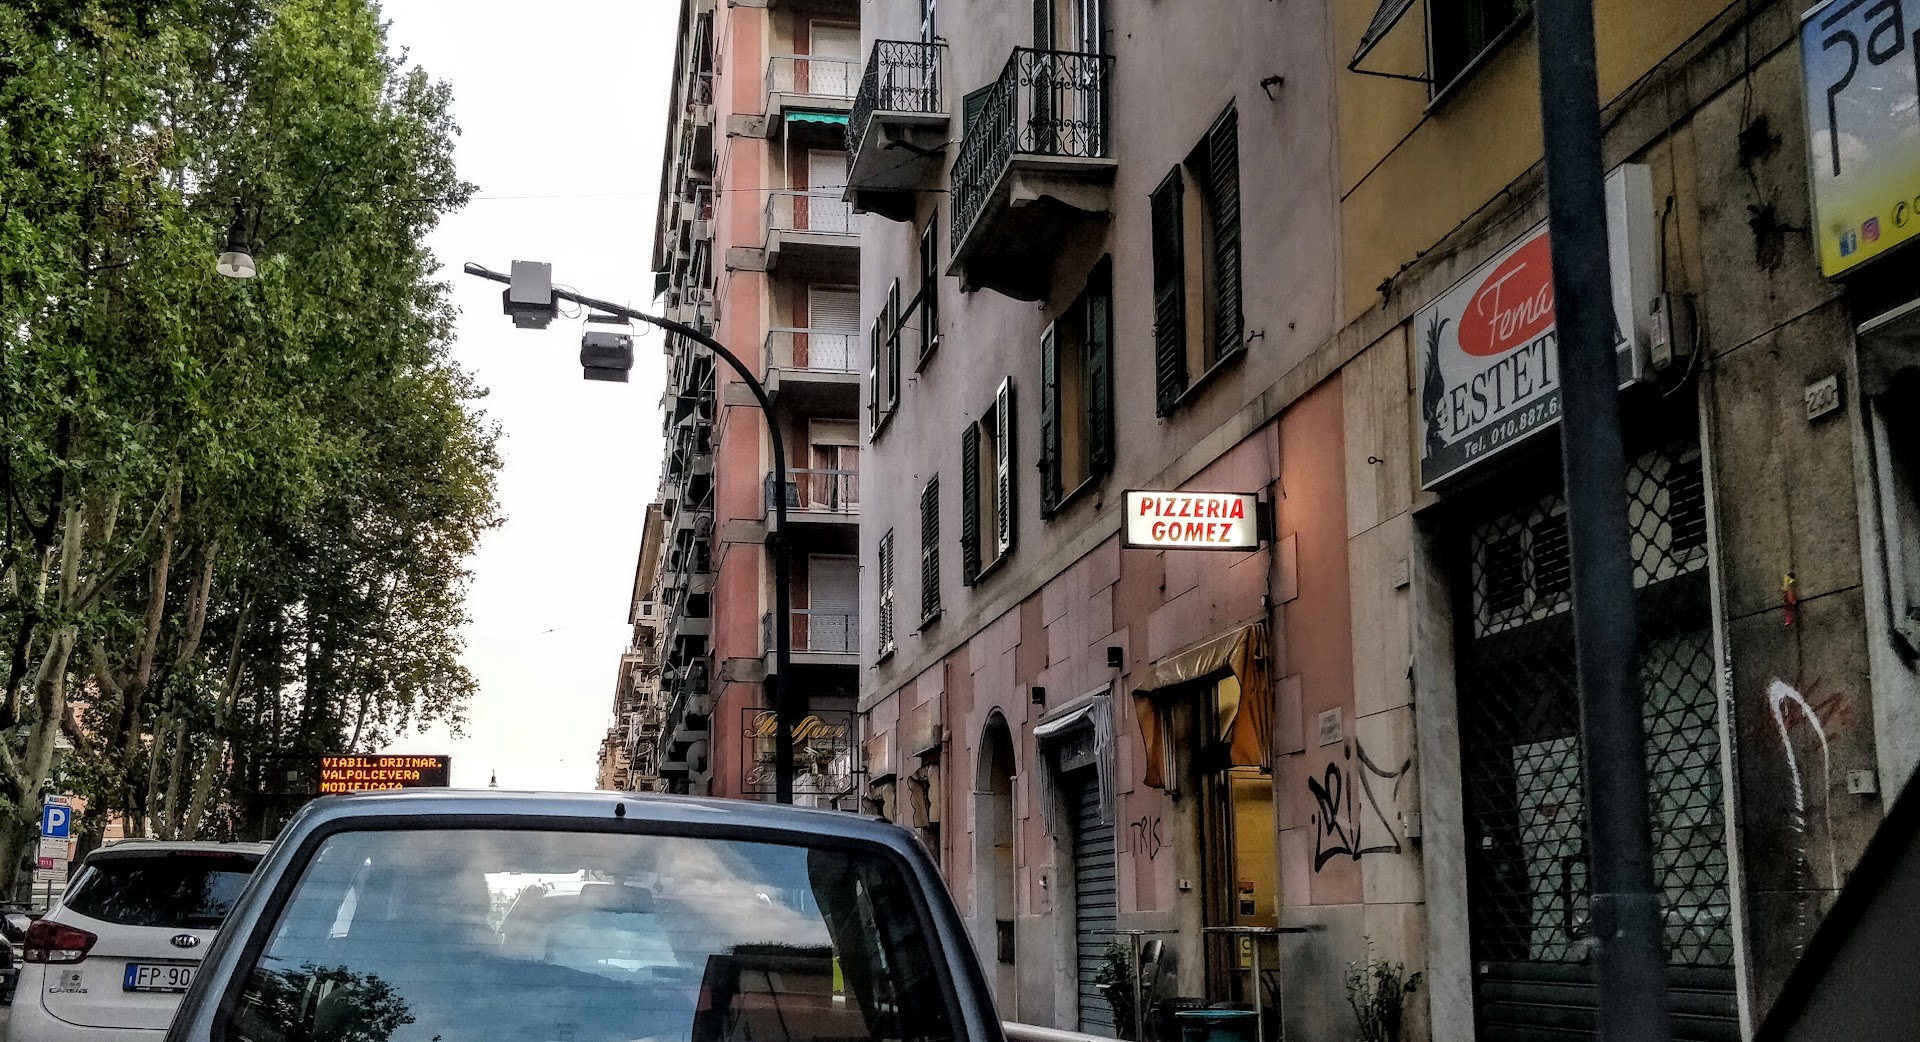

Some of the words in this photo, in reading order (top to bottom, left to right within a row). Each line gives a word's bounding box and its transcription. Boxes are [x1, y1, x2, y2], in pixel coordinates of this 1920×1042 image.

[1477, 262, 1555, 348] Fema
[1464, 436, 1486, 458] Tel.
[1491, 397, 1560, 446] 010.887.6
[1140, 497, 1244, 519] PIZZERIA
[1151, 521, 1233, 542] GOMEZ
[322, 770, 420, 780] VALPOLCEVERA
[321, 782, 404, 792] MODIFICATA
[47, 809, 66, 834] P
[174, 935, 196, 946] KIA
